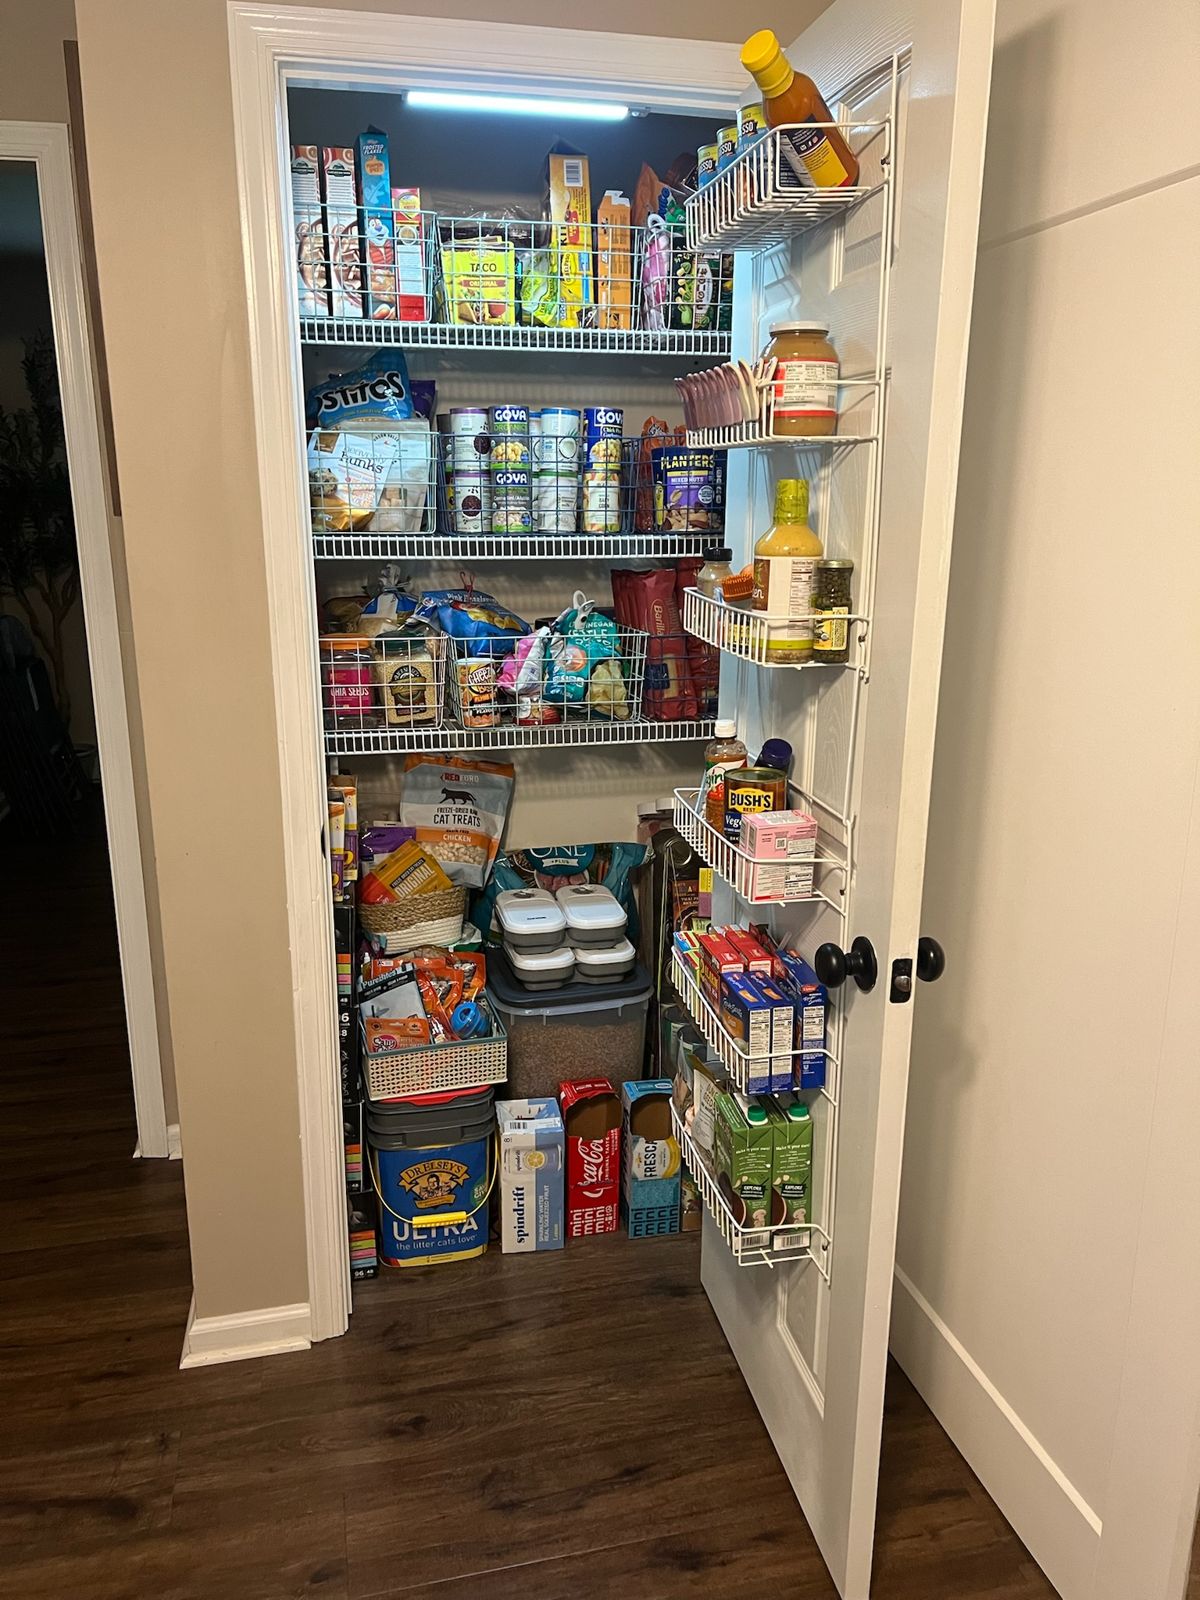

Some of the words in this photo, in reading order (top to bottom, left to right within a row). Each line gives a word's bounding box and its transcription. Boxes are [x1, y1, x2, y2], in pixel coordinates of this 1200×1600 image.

[470, 263, 497, 272] TACO
[495, 409, 527, 421] GOYA
[660, 454, 715, 470] PLANTERS
[496, 473, 527, 485] GOYA
[654, 604, 665, 636] Barilla
[730, 792, 771, 808] BUSH'S
[433, 814, 450, 825] CAT
[453, 814, 481, 827] TREATS
[442, 833, 472, 842] CHICKEN
[394, 863, 436, 899] ORIGINAL
[512, 1185, 529, 1243] spindrift
[570, 1209, 582, 1237] mini
[581, 1208, 593, 1235] mini
[593, 1206, 605, 1233] mini
[631, 1208, 643, 1237] mini
[642, 1207, 654, 1236] mini
[654, 1206, 666, 1234] mini
[666, 1205, 678, 1233] mini
[396, 1243, 411, 1251] the
[413, 1241, 435, 1249] litter
[437, 1238, 456, 1247] cats
